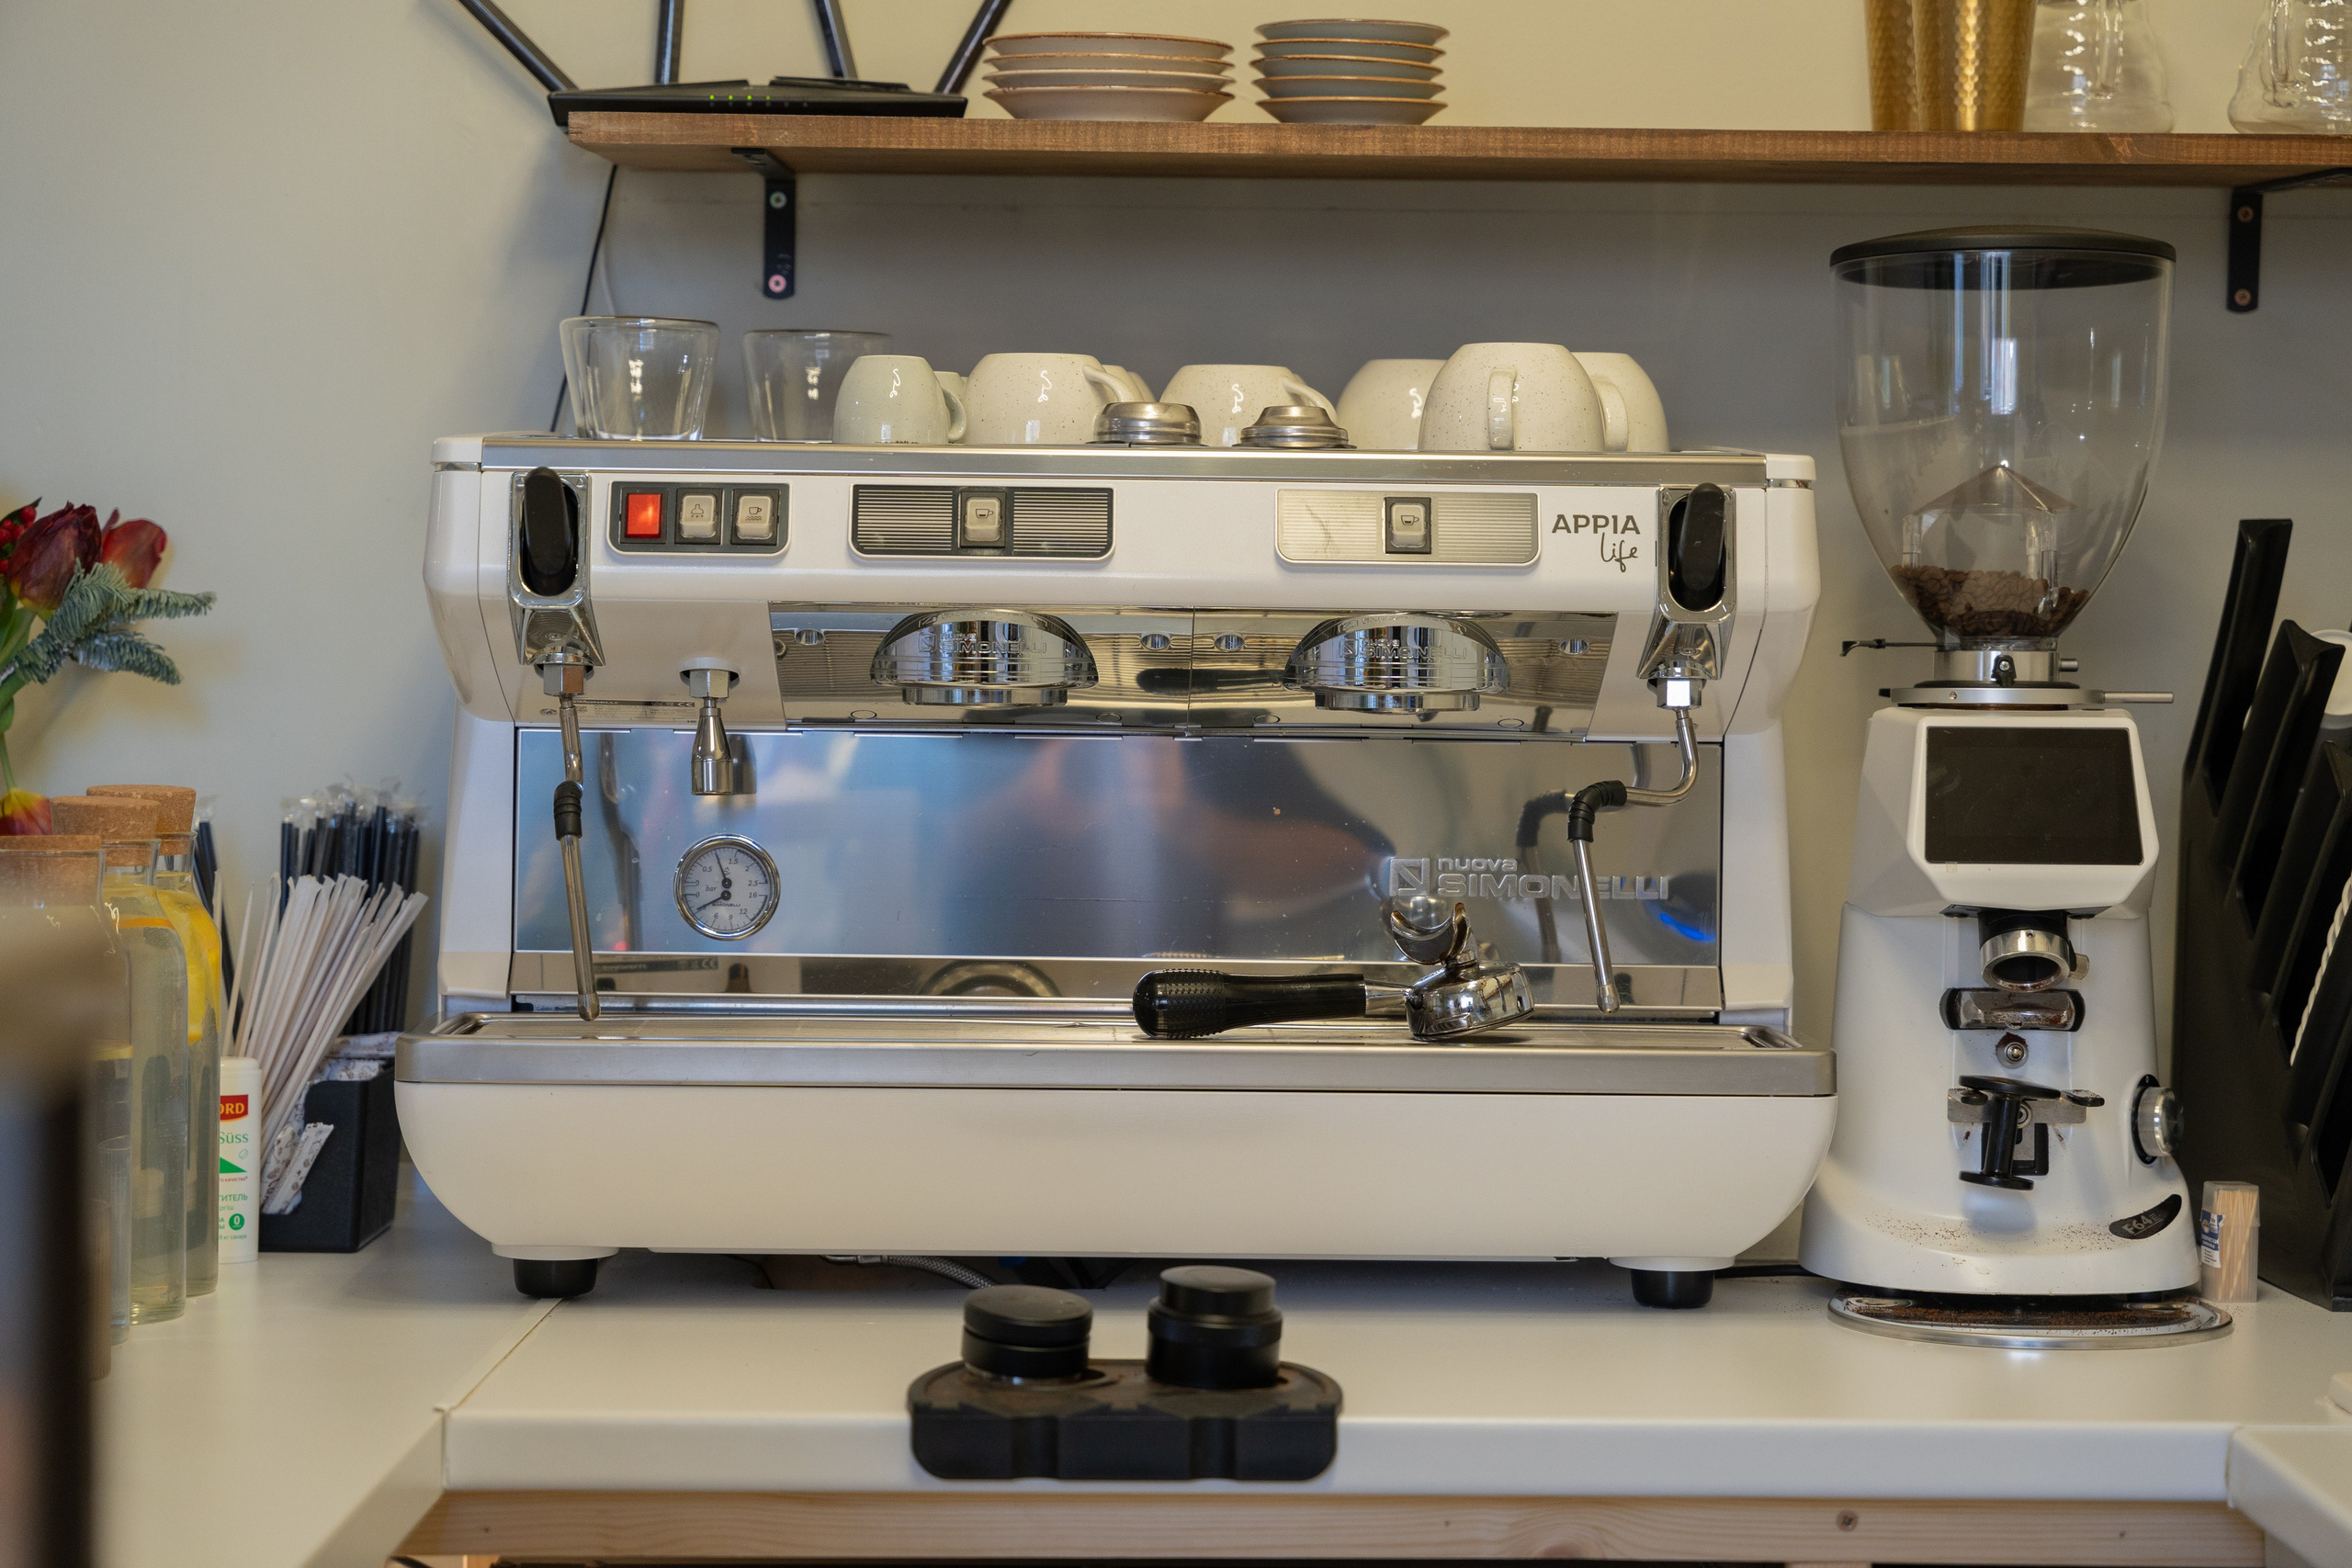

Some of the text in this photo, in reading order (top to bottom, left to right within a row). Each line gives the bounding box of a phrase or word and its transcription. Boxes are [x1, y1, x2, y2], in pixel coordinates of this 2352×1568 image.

[1552, 513, 1641, 535] APPIA
[1600, 532, 1638, 573] life
[940, 641, 1046, 653] SIMONELLI
[1363, 646, 1467, 659] SIMONELLI
[1438, 857, 1518, 872] nuova
